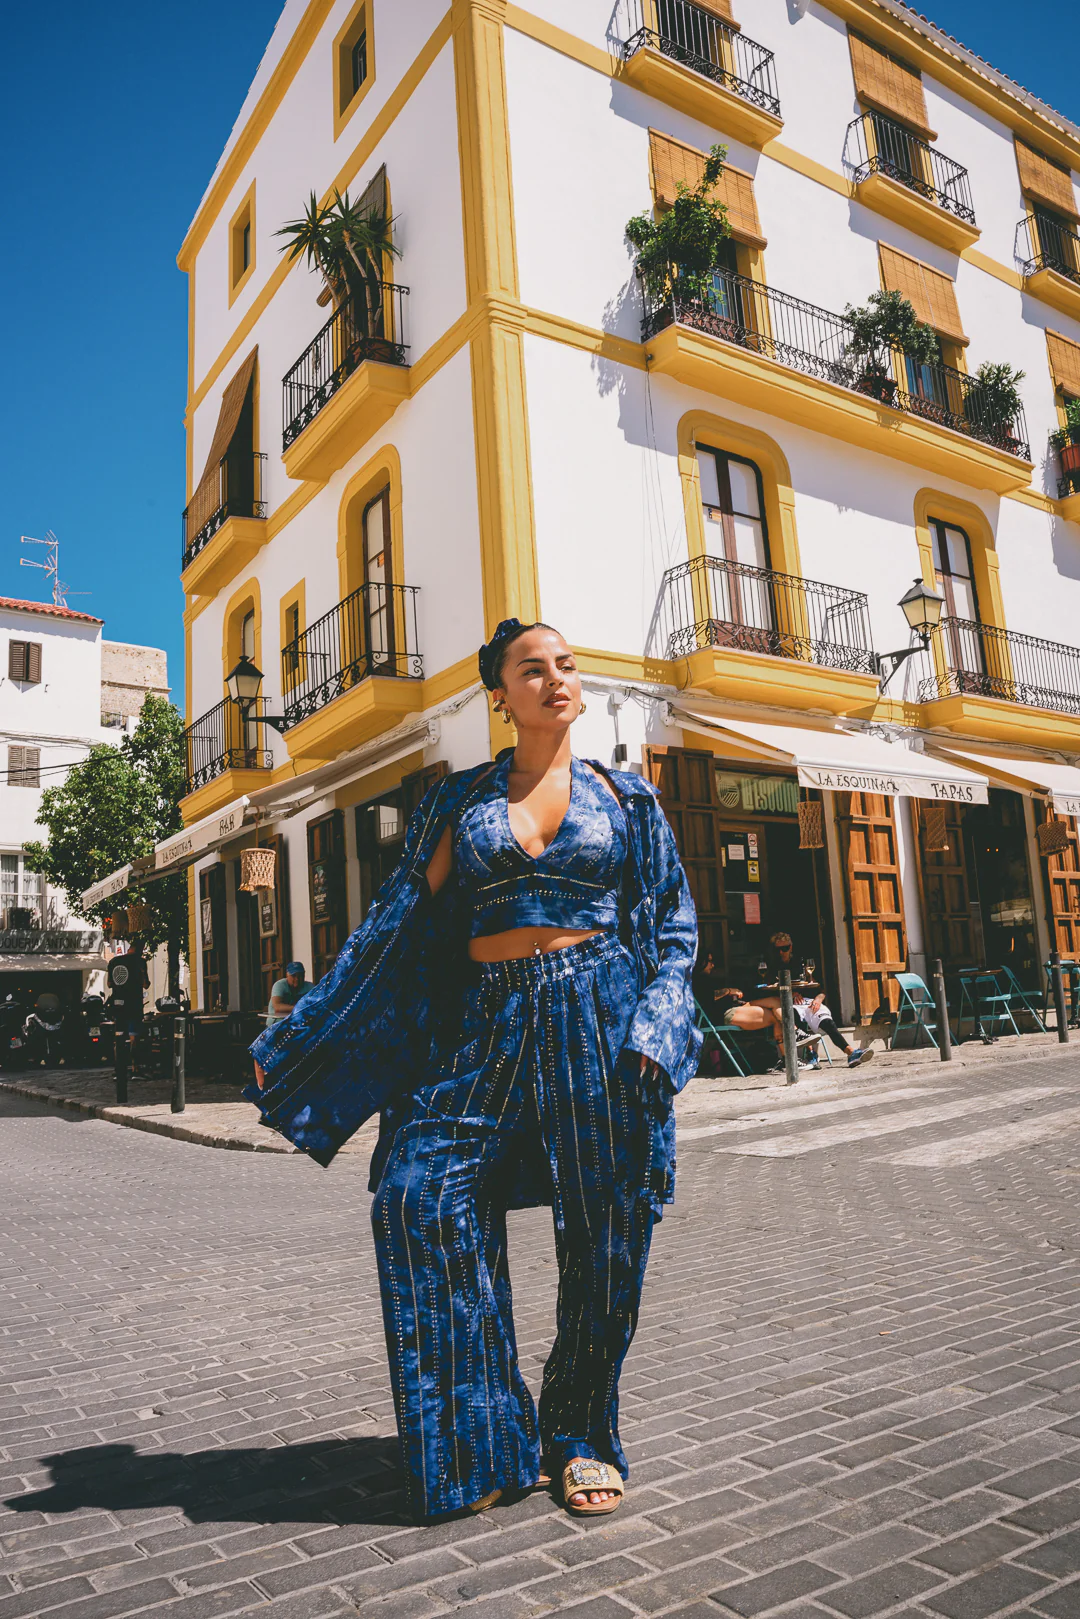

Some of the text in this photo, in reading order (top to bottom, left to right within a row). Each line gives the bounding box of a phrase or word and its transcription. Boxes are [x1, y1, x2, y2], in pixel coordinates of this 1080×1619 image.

[818, 773, 887, 791] LA ESQUINA
[931, 783, 973, 802] TAPAS
[219, 814, 235, 836] BAR
